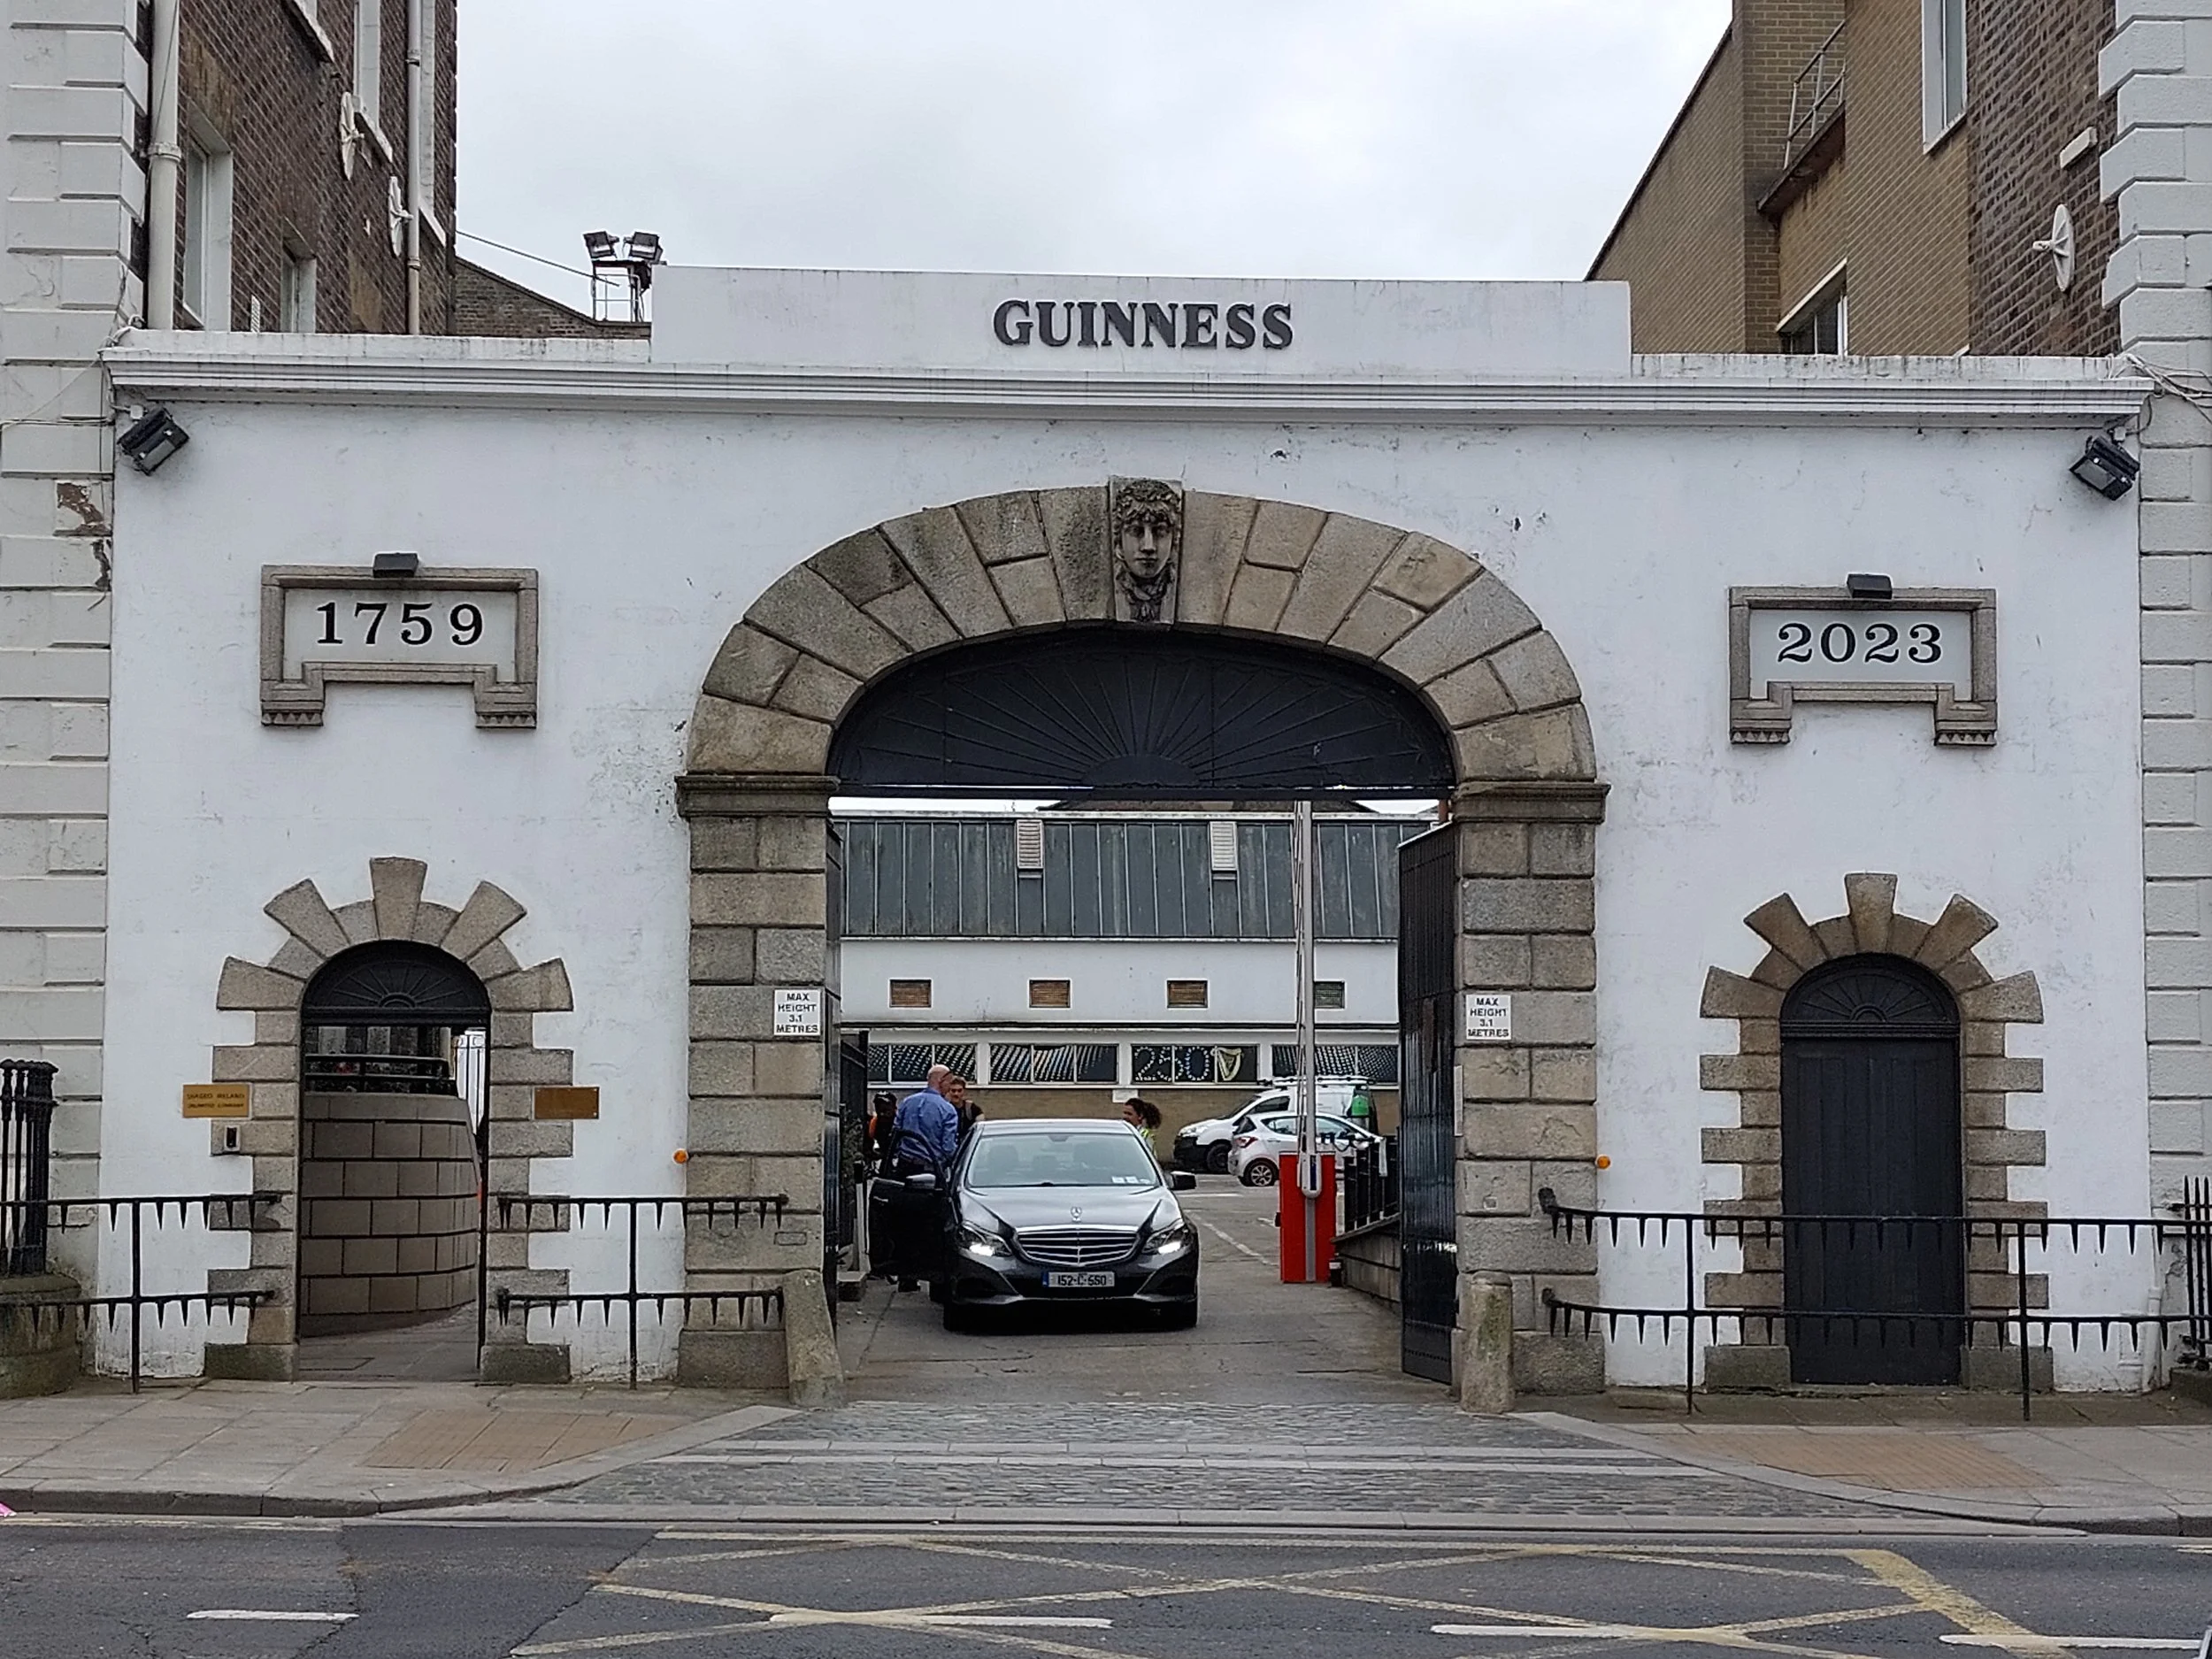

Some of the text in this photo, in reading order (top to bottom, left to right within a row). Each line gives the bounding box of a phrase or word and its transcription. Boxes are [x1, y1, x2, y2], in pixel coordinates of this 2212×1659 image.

[993, 299, 1294, 349] GUINNESS
[316, 602, 483, 646] 1759
[1777, 622, 1943, 664] 2023
[787, 993, 810, 1002] MAX
[1476, 997, 1499, 1007] MAX
[778, 1003, 817, 1012] HEIGHT
[1470, 1008, 1507, 1017] HEIGHT
[788, 1014, 803, 1023] 3.1
[1479, 1018, 1494, 1027] 3.1
[776, 1024, 818, 1033] METRES
[1467, 1028, 1509, 1037] METRES
[1134, 1046, 1210, 1081] 250
